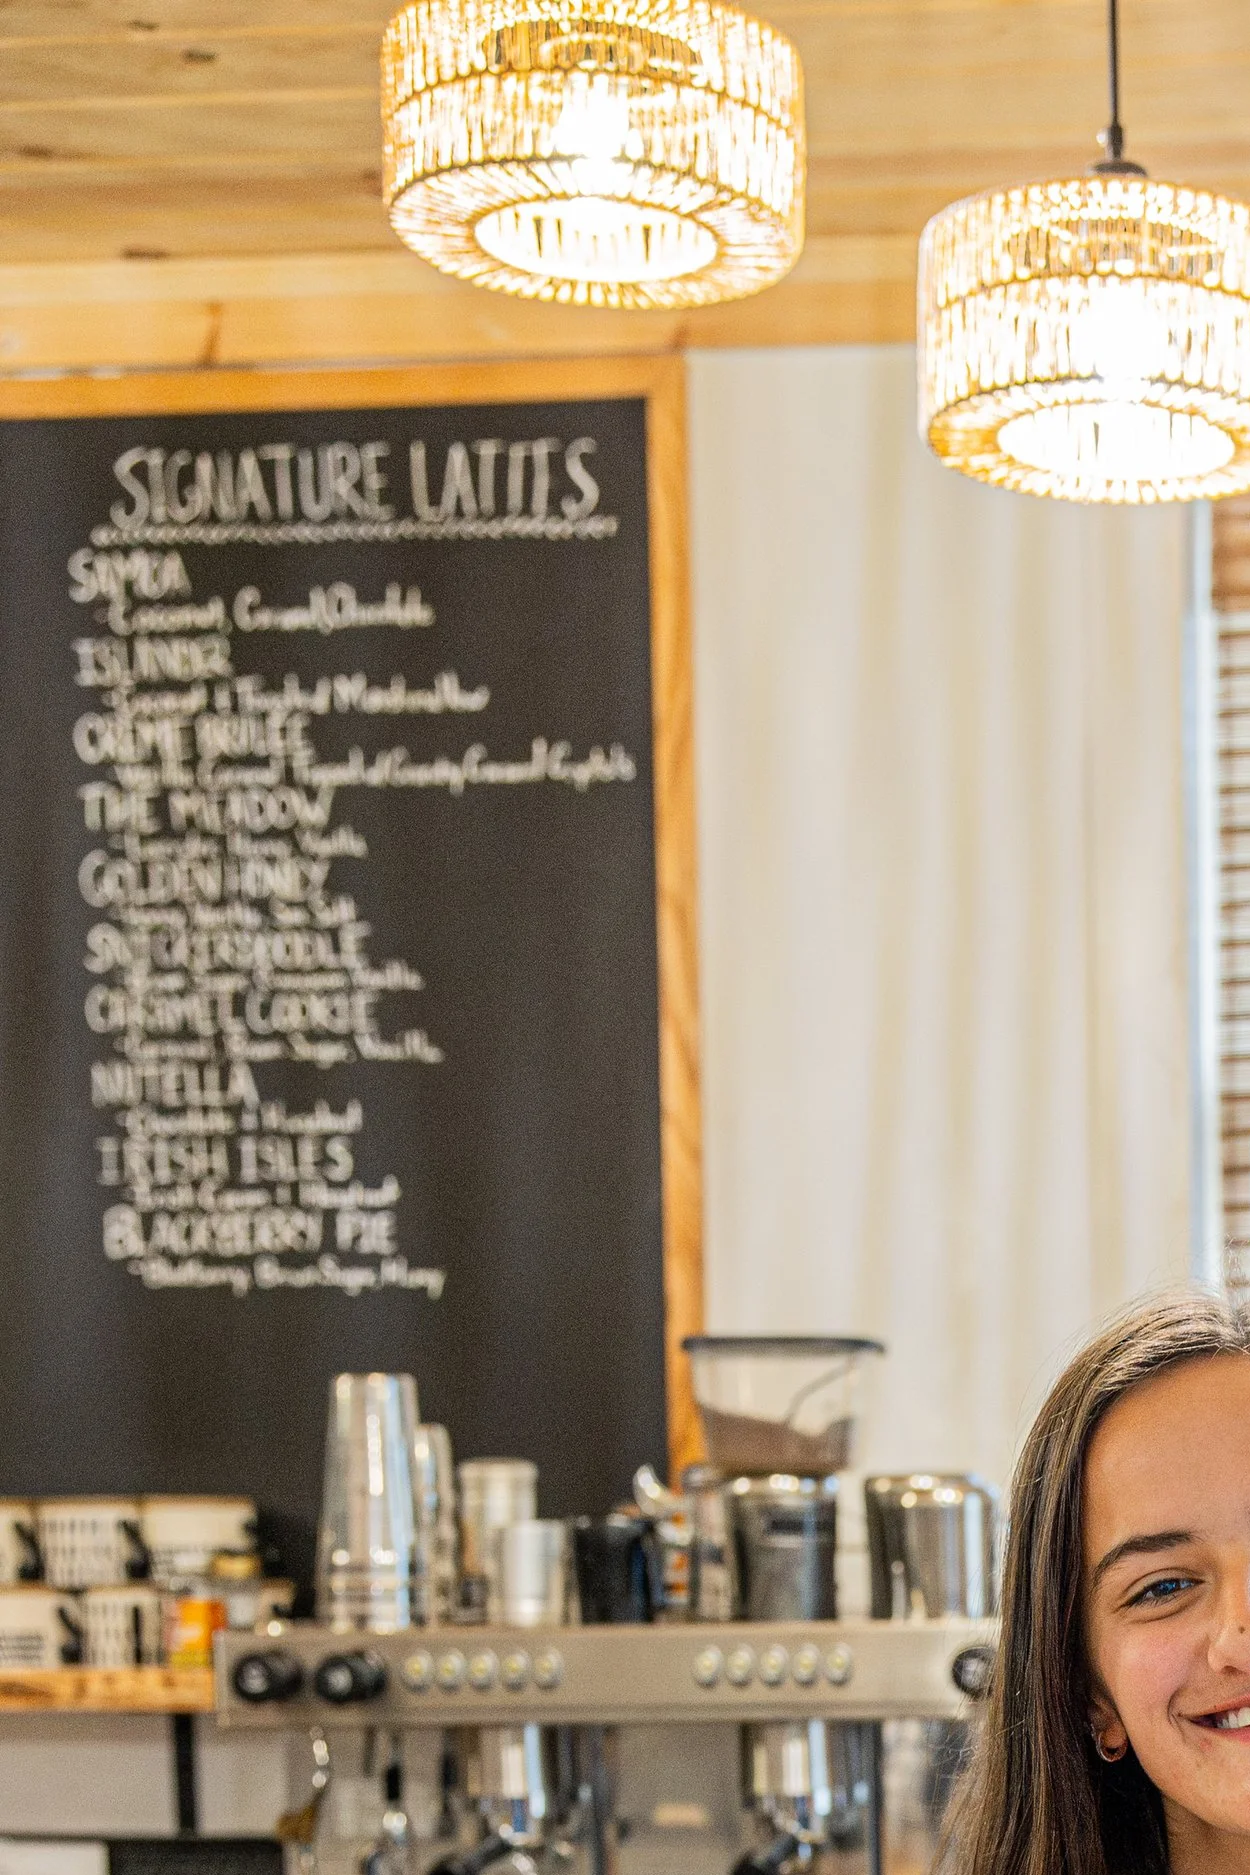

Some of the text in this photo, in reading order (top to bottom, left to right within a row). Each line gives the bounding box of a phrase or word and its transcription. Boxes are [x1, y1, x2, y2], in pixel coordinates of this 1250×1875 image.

[111, 441, 393, 526] SIGNATURE
[78, 782, 335, 831] THE MEADOW
[78, 850, 223, 907] GOLDEN
[244, 984, 380, 1034] COOKIE
[92, 1060, 258, 1108] NUTELLA
[96, 1134, 355, 1185] IRISH ISLES
[335, 1206, 396, 1256] PIE
